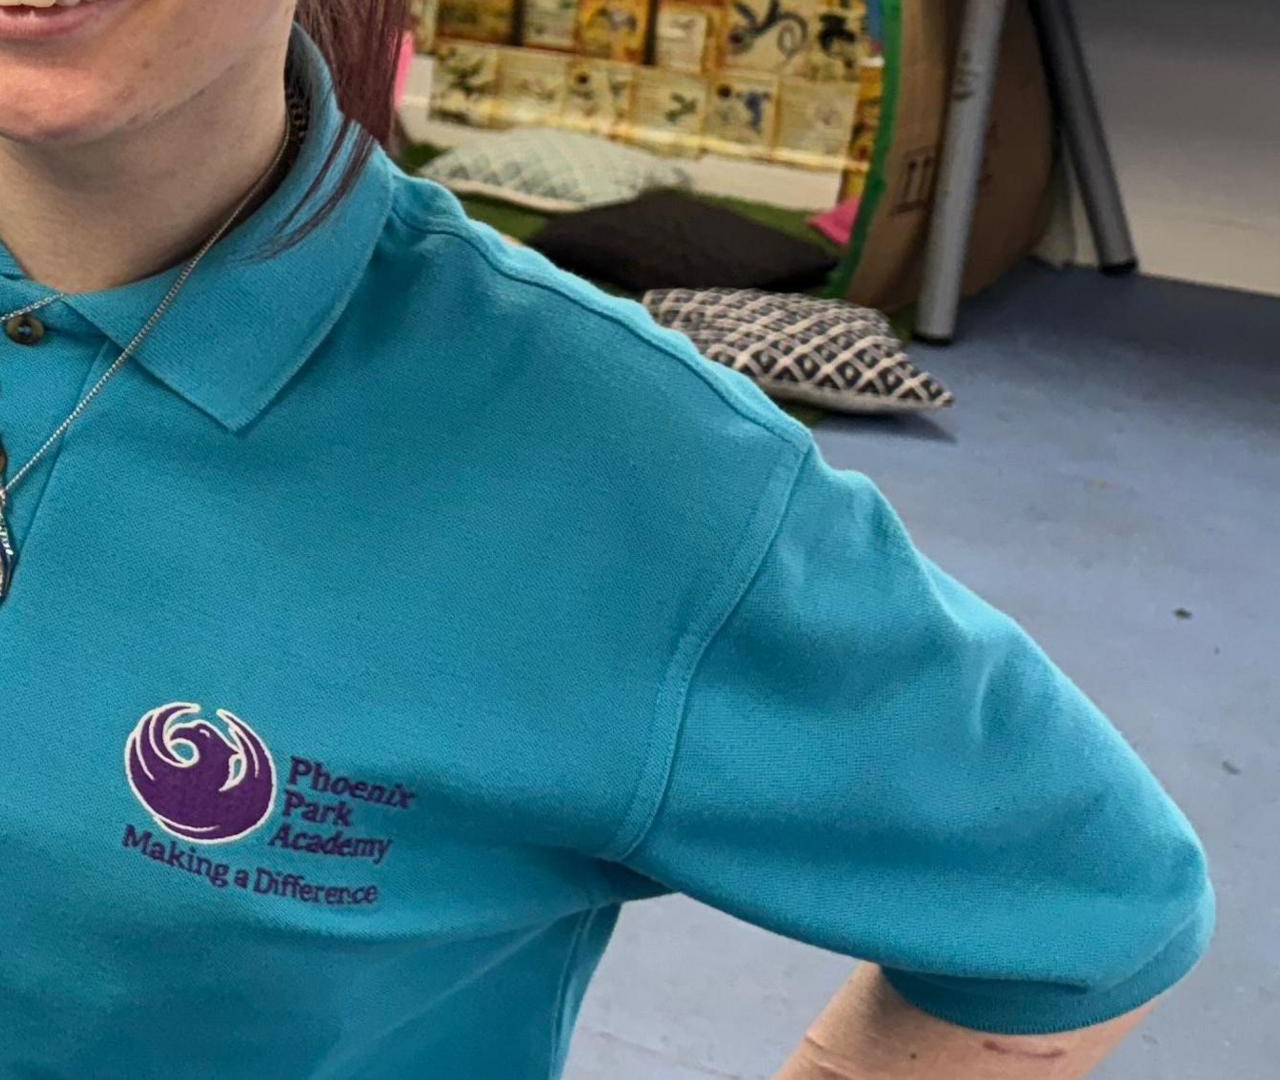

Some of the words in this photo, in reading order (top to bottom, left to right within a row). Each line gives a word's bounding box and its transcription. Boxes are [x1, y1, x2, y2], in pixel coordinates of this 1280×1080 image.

[286, 755, 416, 809] Phoenix
[282, 789, 355, 827] Park
[121, 823, 230, 889] Making
[233, 870, 249, 889] a
[252, 867, 379, 906] Difference
[267, 823, 393, 865] Academy
